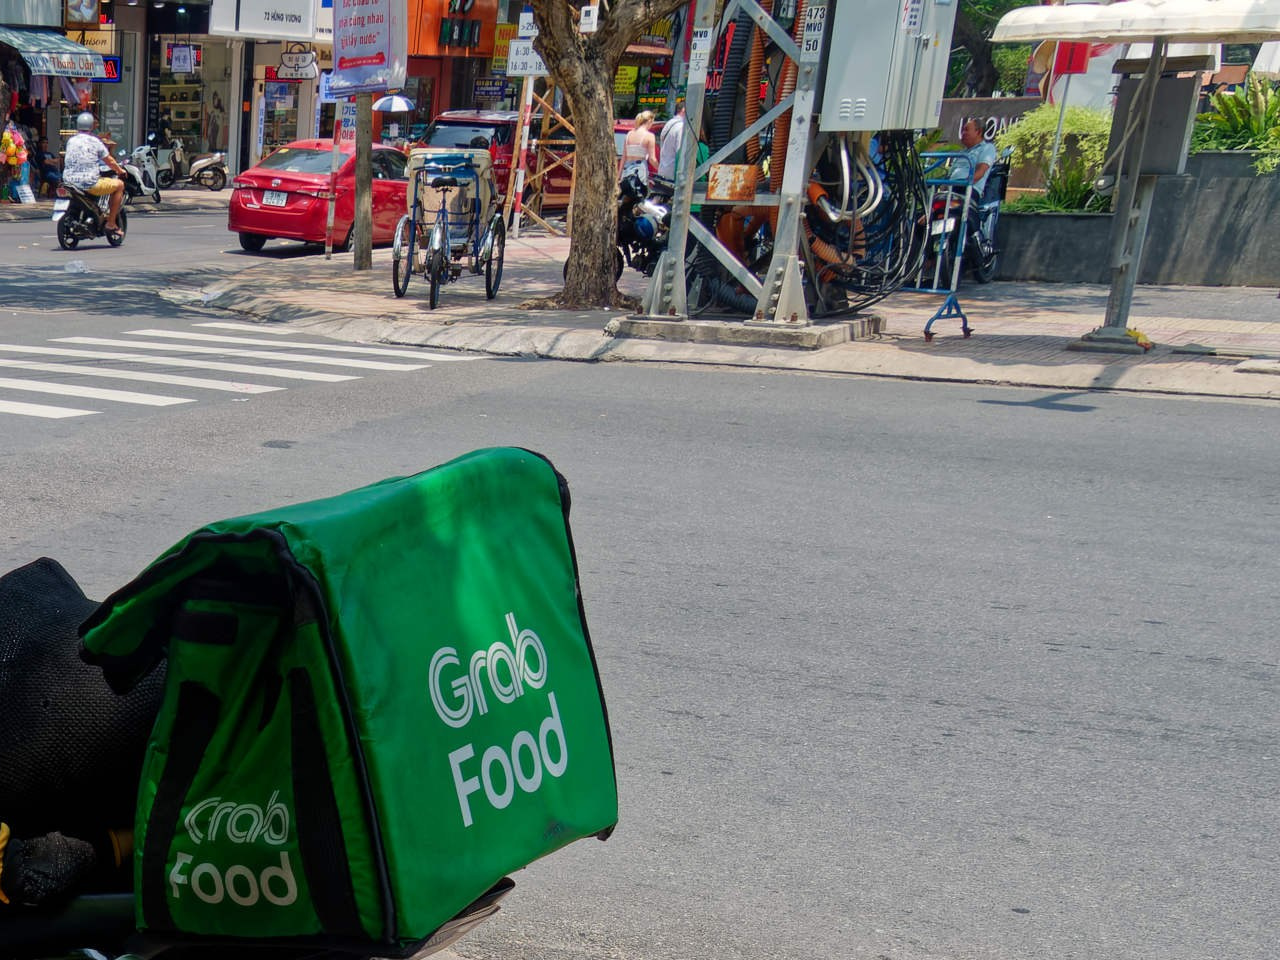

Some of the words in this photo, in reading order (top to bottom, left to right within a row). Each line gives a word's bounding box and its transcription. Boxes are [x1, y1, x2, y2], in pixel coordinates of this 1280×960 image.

[807, 6, 825, 20] 473
[515, 46, 530, 57] 6:30
[805, 39, 819, 51] 50
[510, 61, 528, 71] 16:30
[428, 611, 548, 729] Grab
[447, 690, 569, 829] Food
[167, 850, 298, 906] Food
